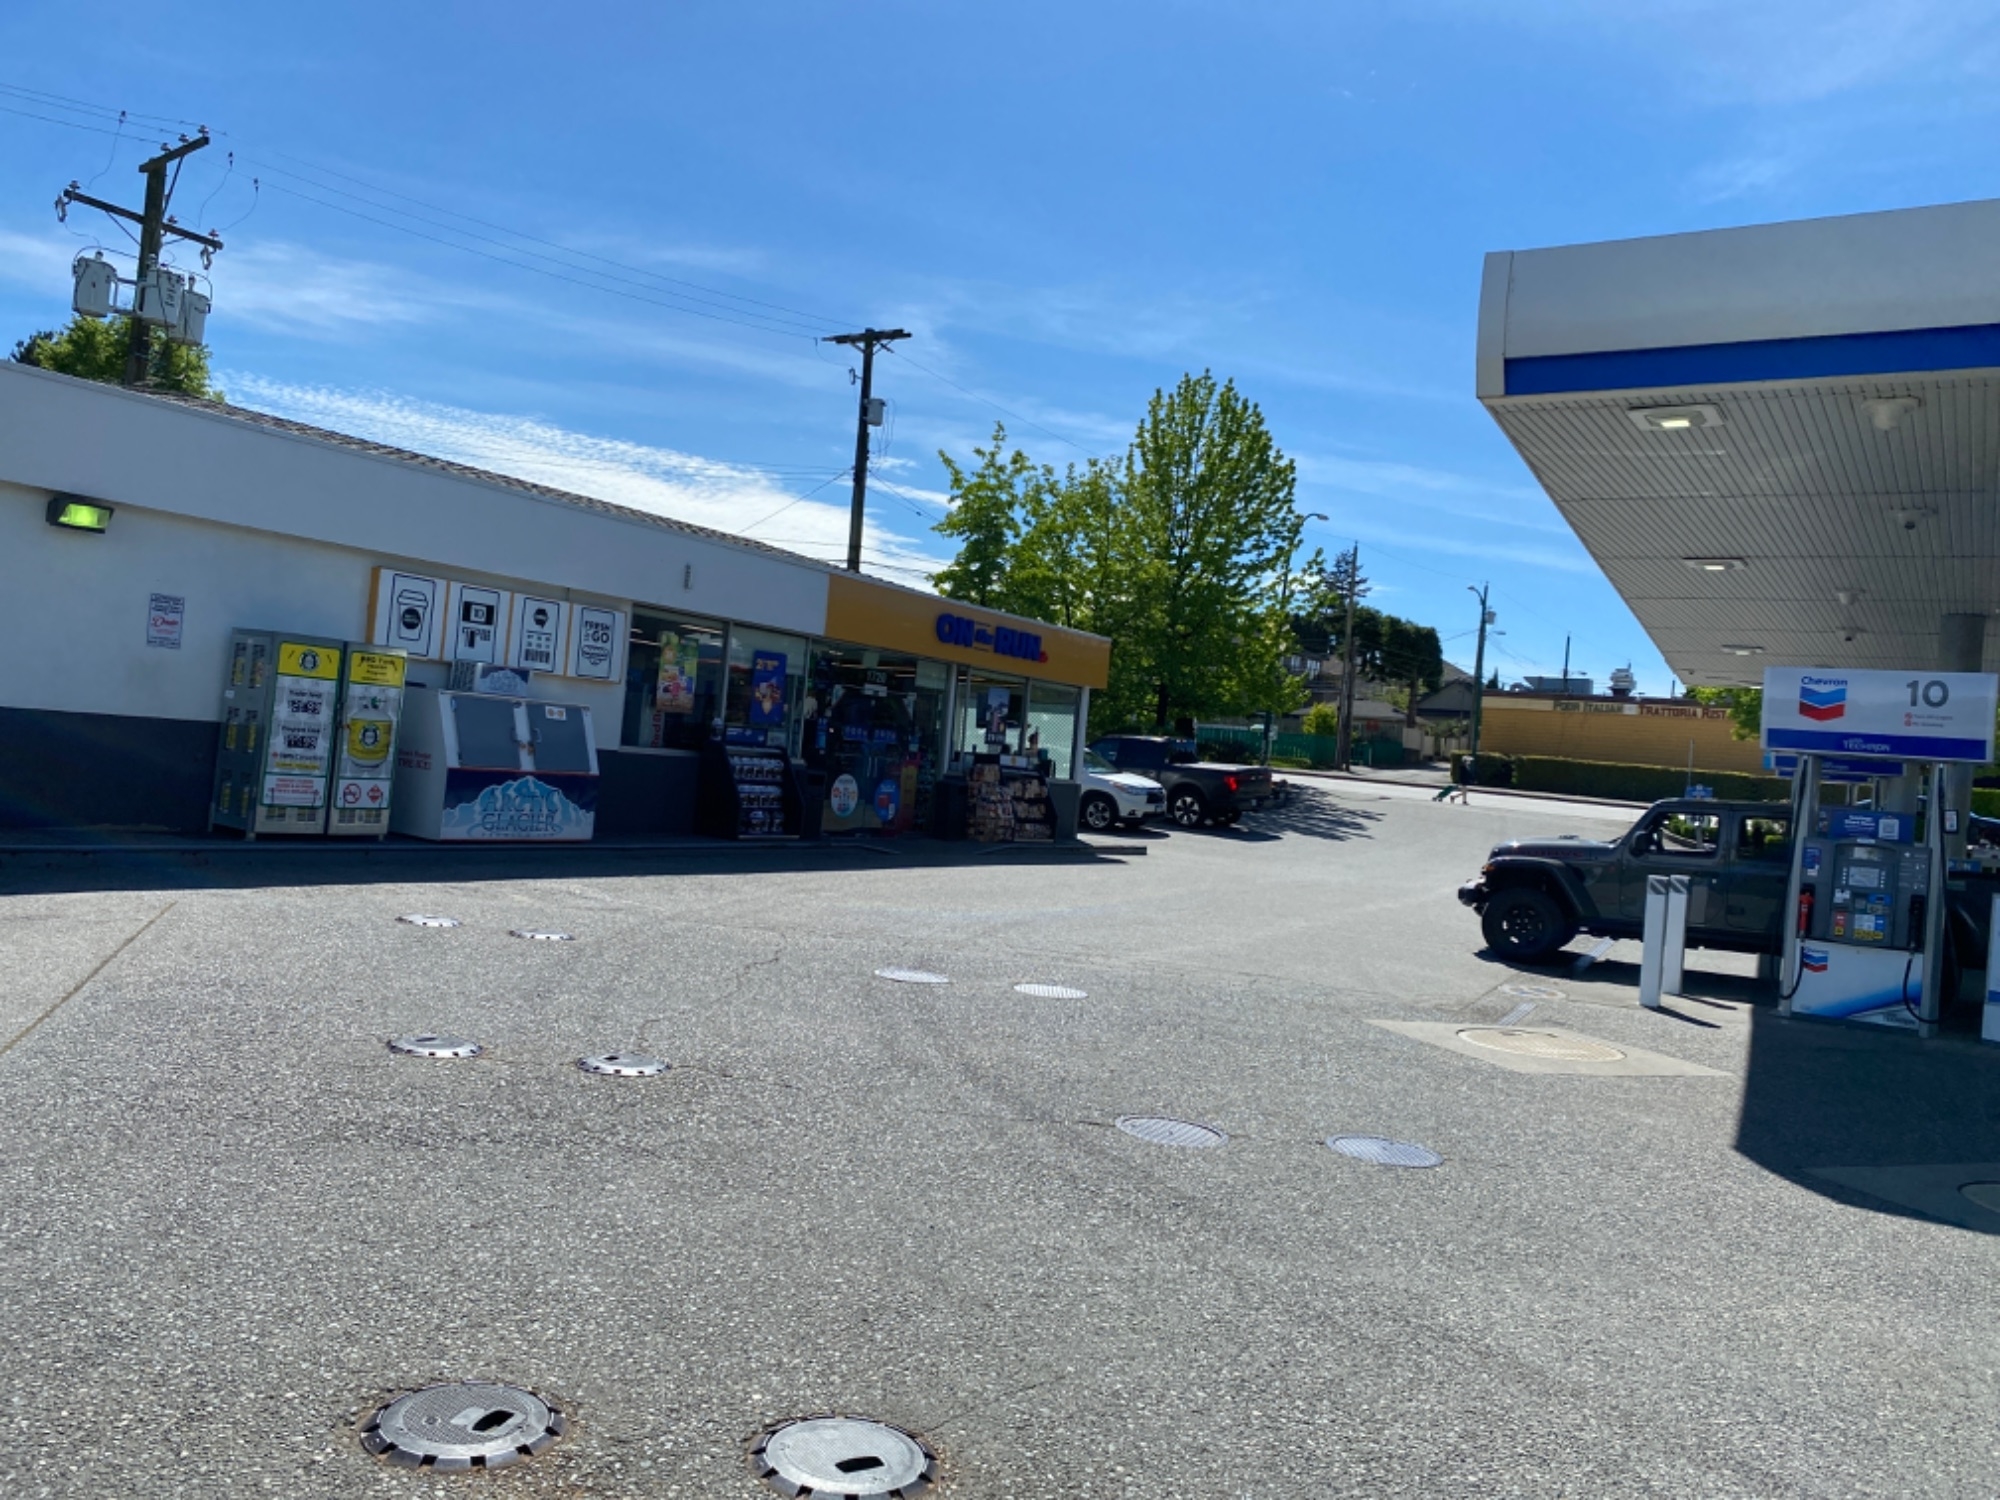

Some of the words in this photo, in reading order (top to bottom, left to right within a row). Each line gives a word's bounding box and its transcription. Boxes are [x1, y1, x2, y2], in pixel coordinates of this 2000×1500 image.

[591, 630, 610, 643] GO
[936, 613, 975, 648] ON
[993, 627, 1042, 662] RUN
[1801, 676, 1848, 685] Chevron
[1906, 680, 1949, 708] 10
[1639, 703, 1697, 717] TRATTORIA
[1842, 739, 1891, 753] TECHRON
[483, 787, 560, 812] ARCTIC
[482, 812, 557, 832] GLACIER
